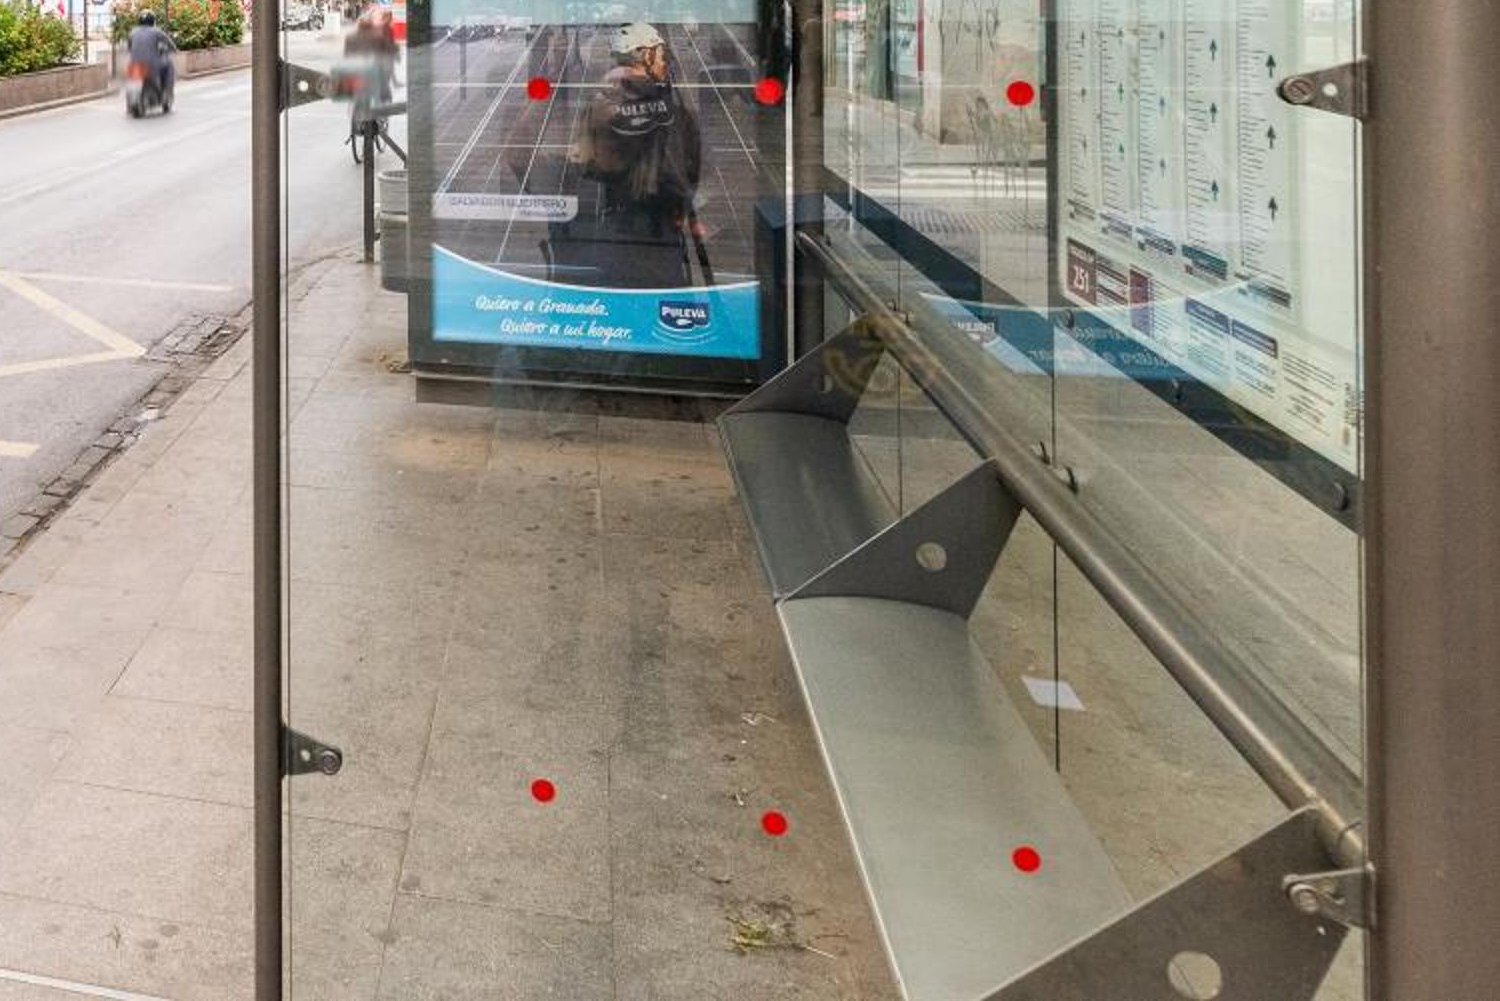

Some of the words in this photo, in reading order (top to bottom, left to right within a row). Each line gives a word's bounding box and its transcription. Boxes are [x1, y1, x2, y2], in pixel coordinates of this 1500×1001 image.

[612, 100, 668, 117] PULEVA
[475, 294, 521, 312] Quiero
[523, 300, 533, 312] a
[538, 297, 609, 316] Granada.
[661, 305, 707, 319] PULEVA
[500, 318, 548, 335] Quiero
[549, 323, 559, 335] a
[563, 321, 583, 336] mi
[587, 321, 633, 344] hogar.
